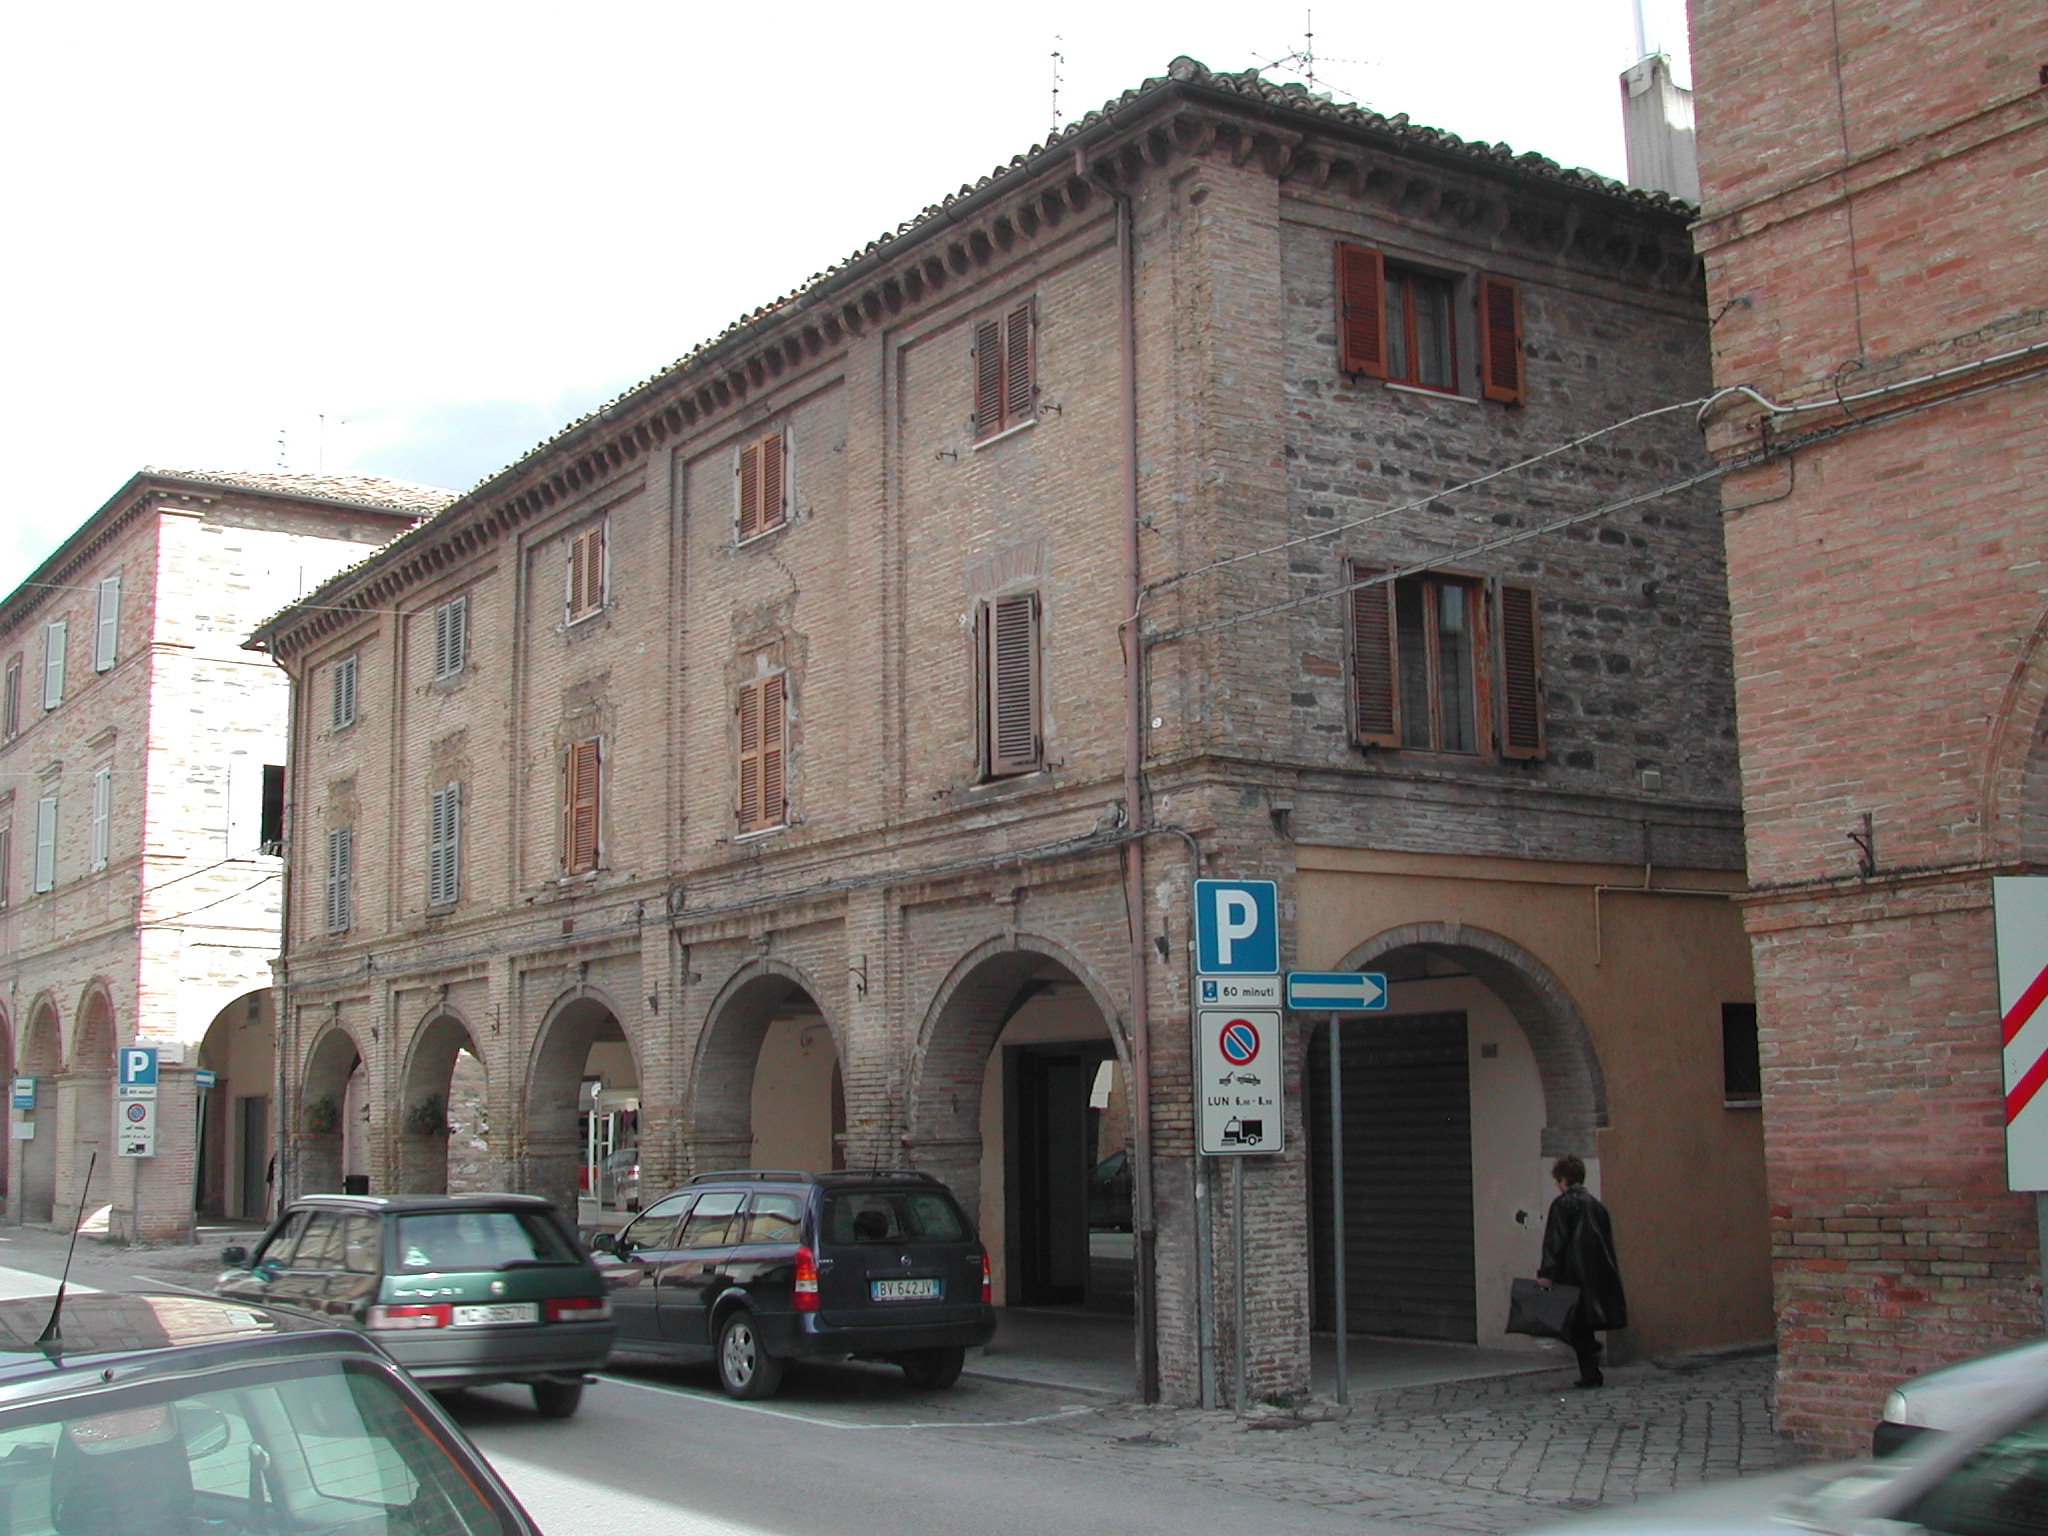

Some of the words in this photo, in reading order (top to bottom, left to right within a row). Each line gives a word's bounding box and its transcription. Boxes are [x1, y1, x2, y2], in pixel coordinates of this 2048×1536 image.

[1215, 889, 1259, 965] P
[1223, 986, 1238, 997] 60
[1242, 987, 1274, 997] minuti
[128, 1051, 149, 1082] P
[1208, 1096, 1230, 1106] LUN
[880, 1282, 894, 1296] BV
